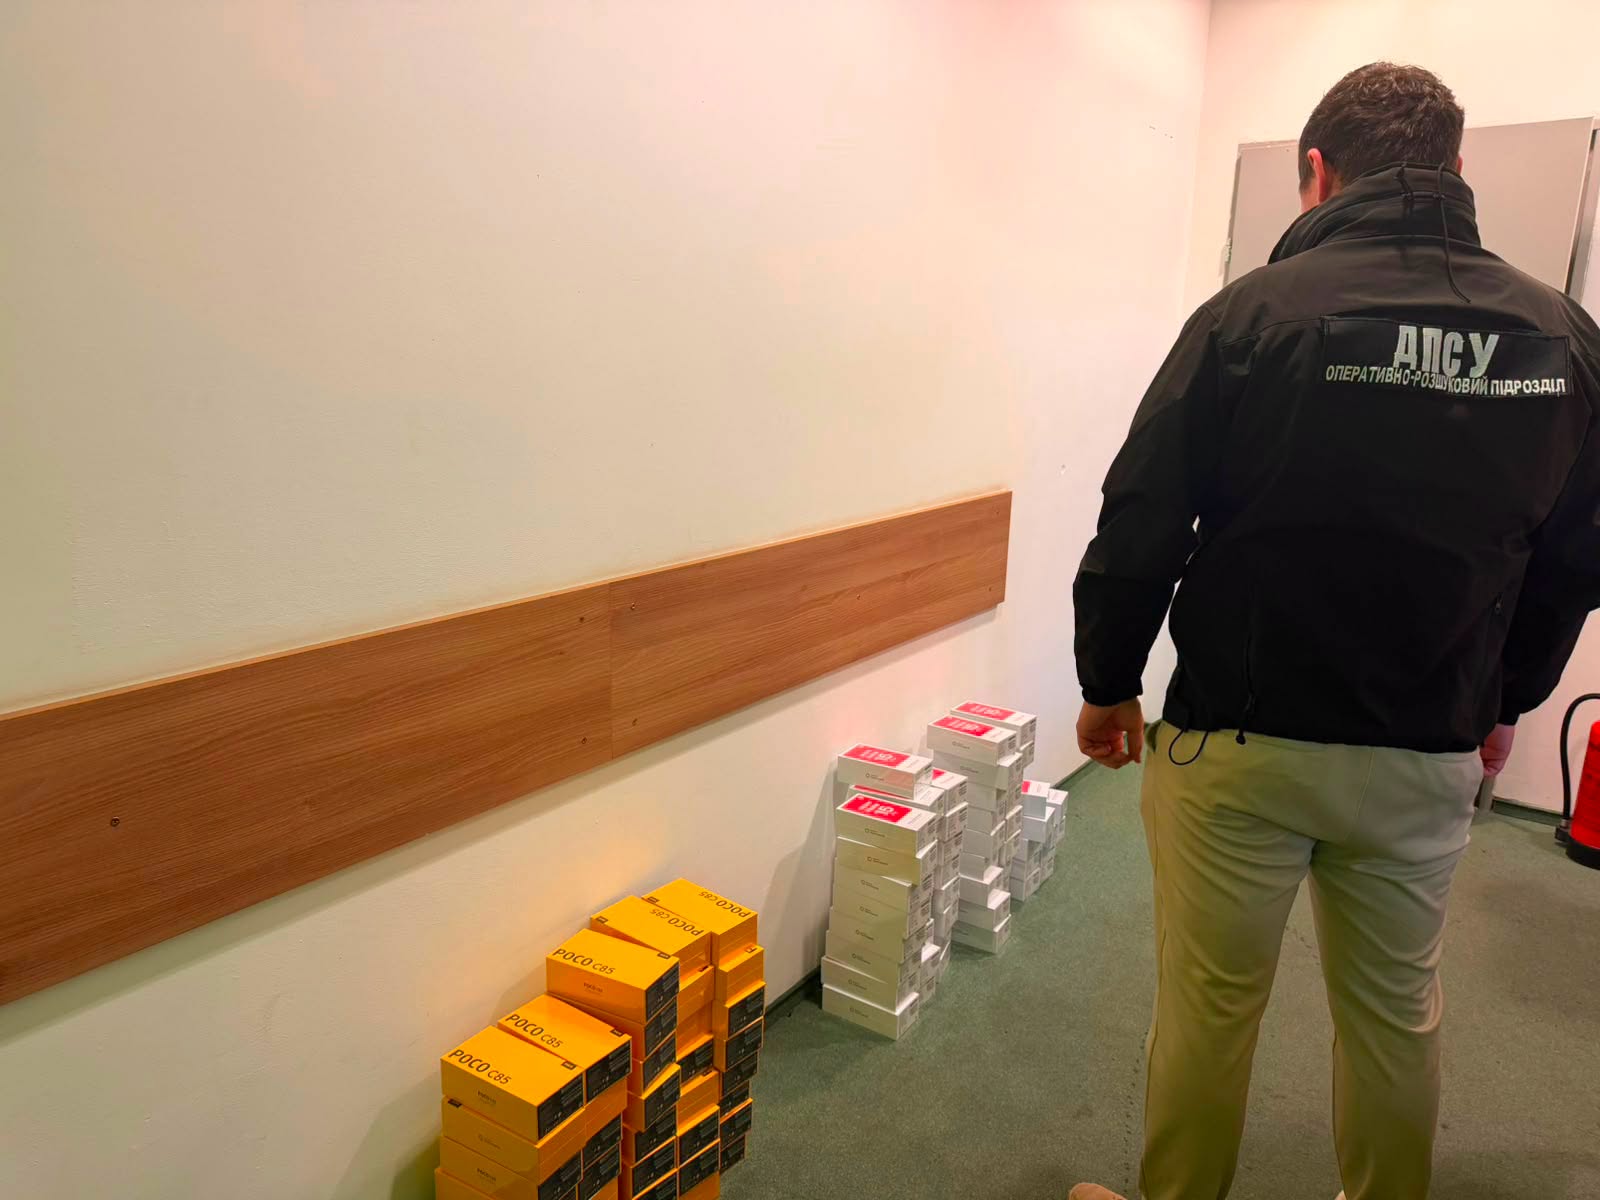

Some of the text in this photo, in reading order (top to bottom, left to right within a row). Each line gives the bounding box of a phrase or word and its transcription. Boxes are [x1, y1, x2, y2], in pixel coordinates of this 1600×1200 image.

[1393, 325, 1500, 379] ДПСУ
[1490, 378, 1566, 397] ПІДРОЗДІЛ
[698, 891, 751, 918] POCO C85
[649, 908, 704, 936] POCO C85
[552, 948, 616, 975] POCO C85
[505, 1014, 563, 1049] POCO C85
[448, 1049, 512, 1085] POCO C85
